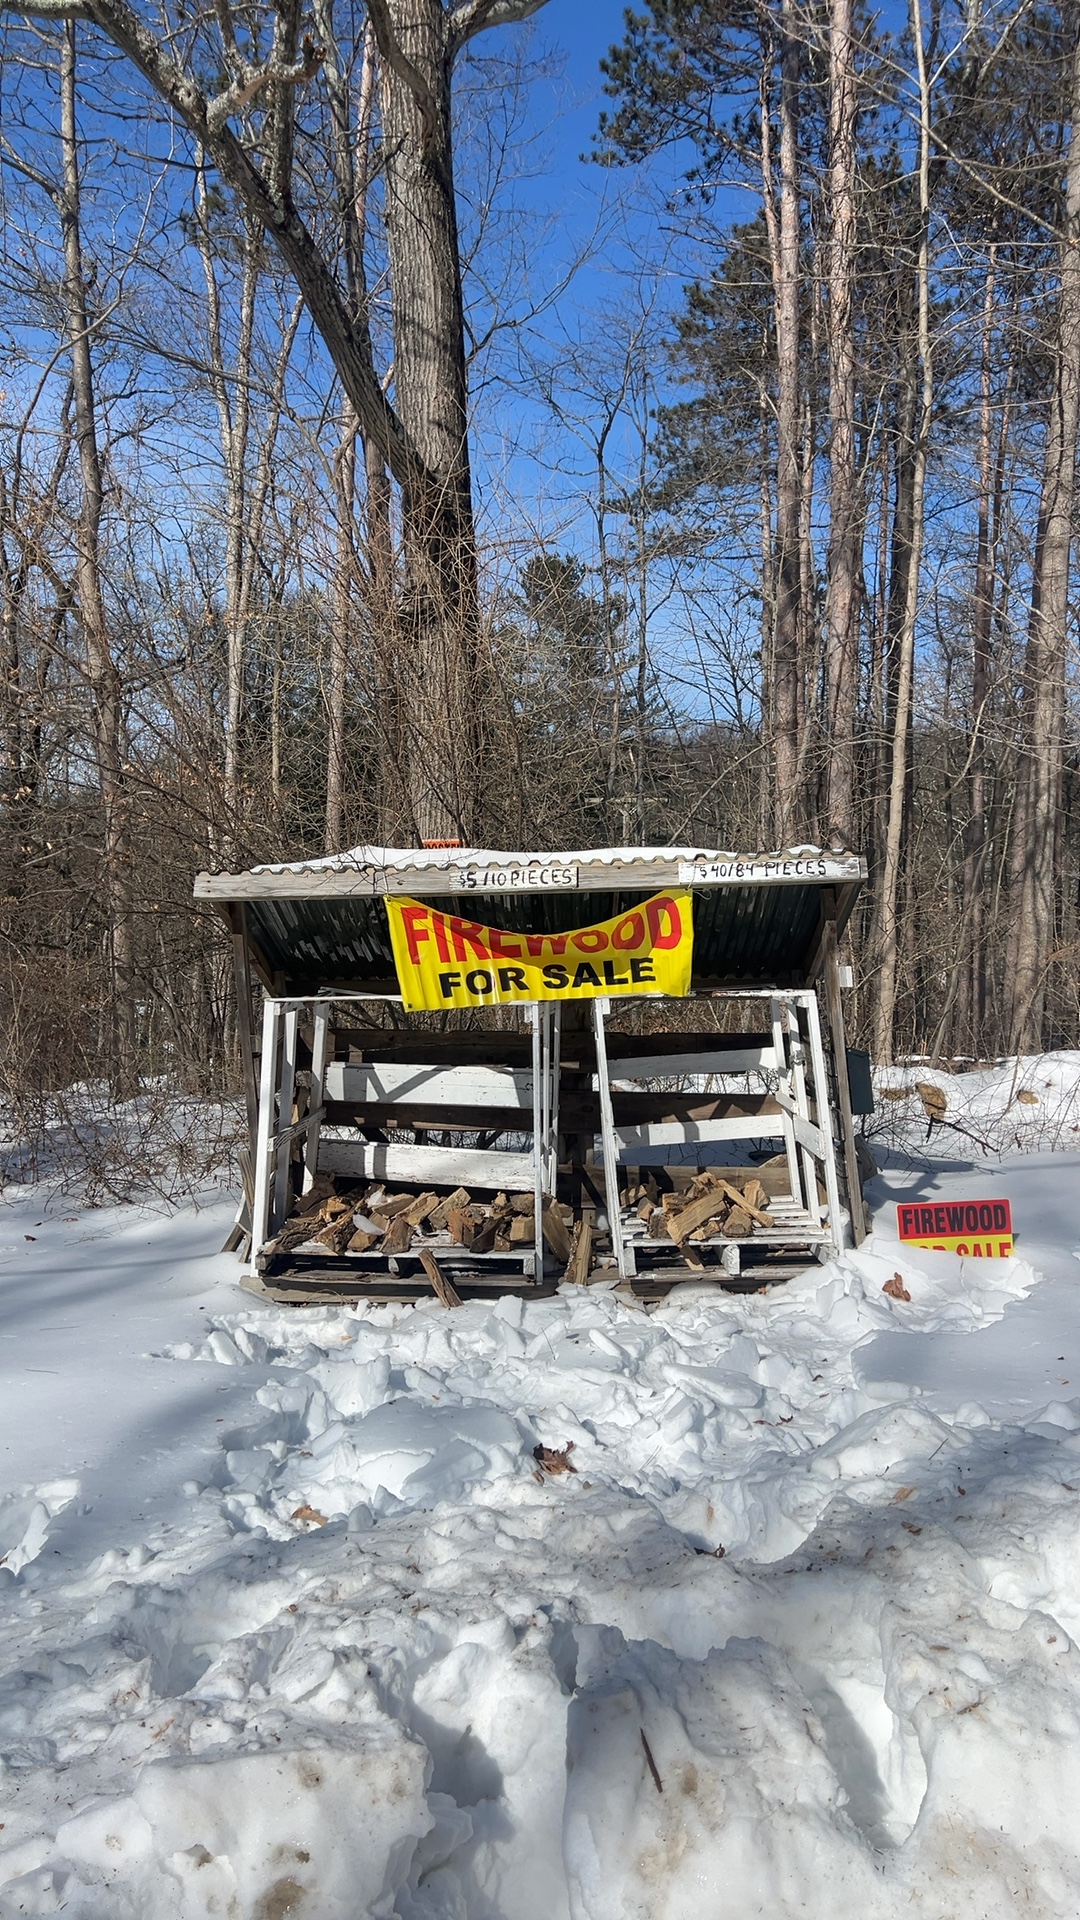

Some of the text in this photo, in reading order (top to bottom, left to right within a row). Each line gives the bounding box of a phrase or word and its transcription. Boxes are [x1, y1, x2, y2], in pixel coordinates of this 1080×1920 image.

[510, 868, 572, 886] PIECES
[765, 859, 827, 877] PIECES
[401, 896, 682, 965] FIREWOOD
[438, 957, 656, 998] FOR SALE
[902, 1204, 1006, 1234] FIREWOOD
